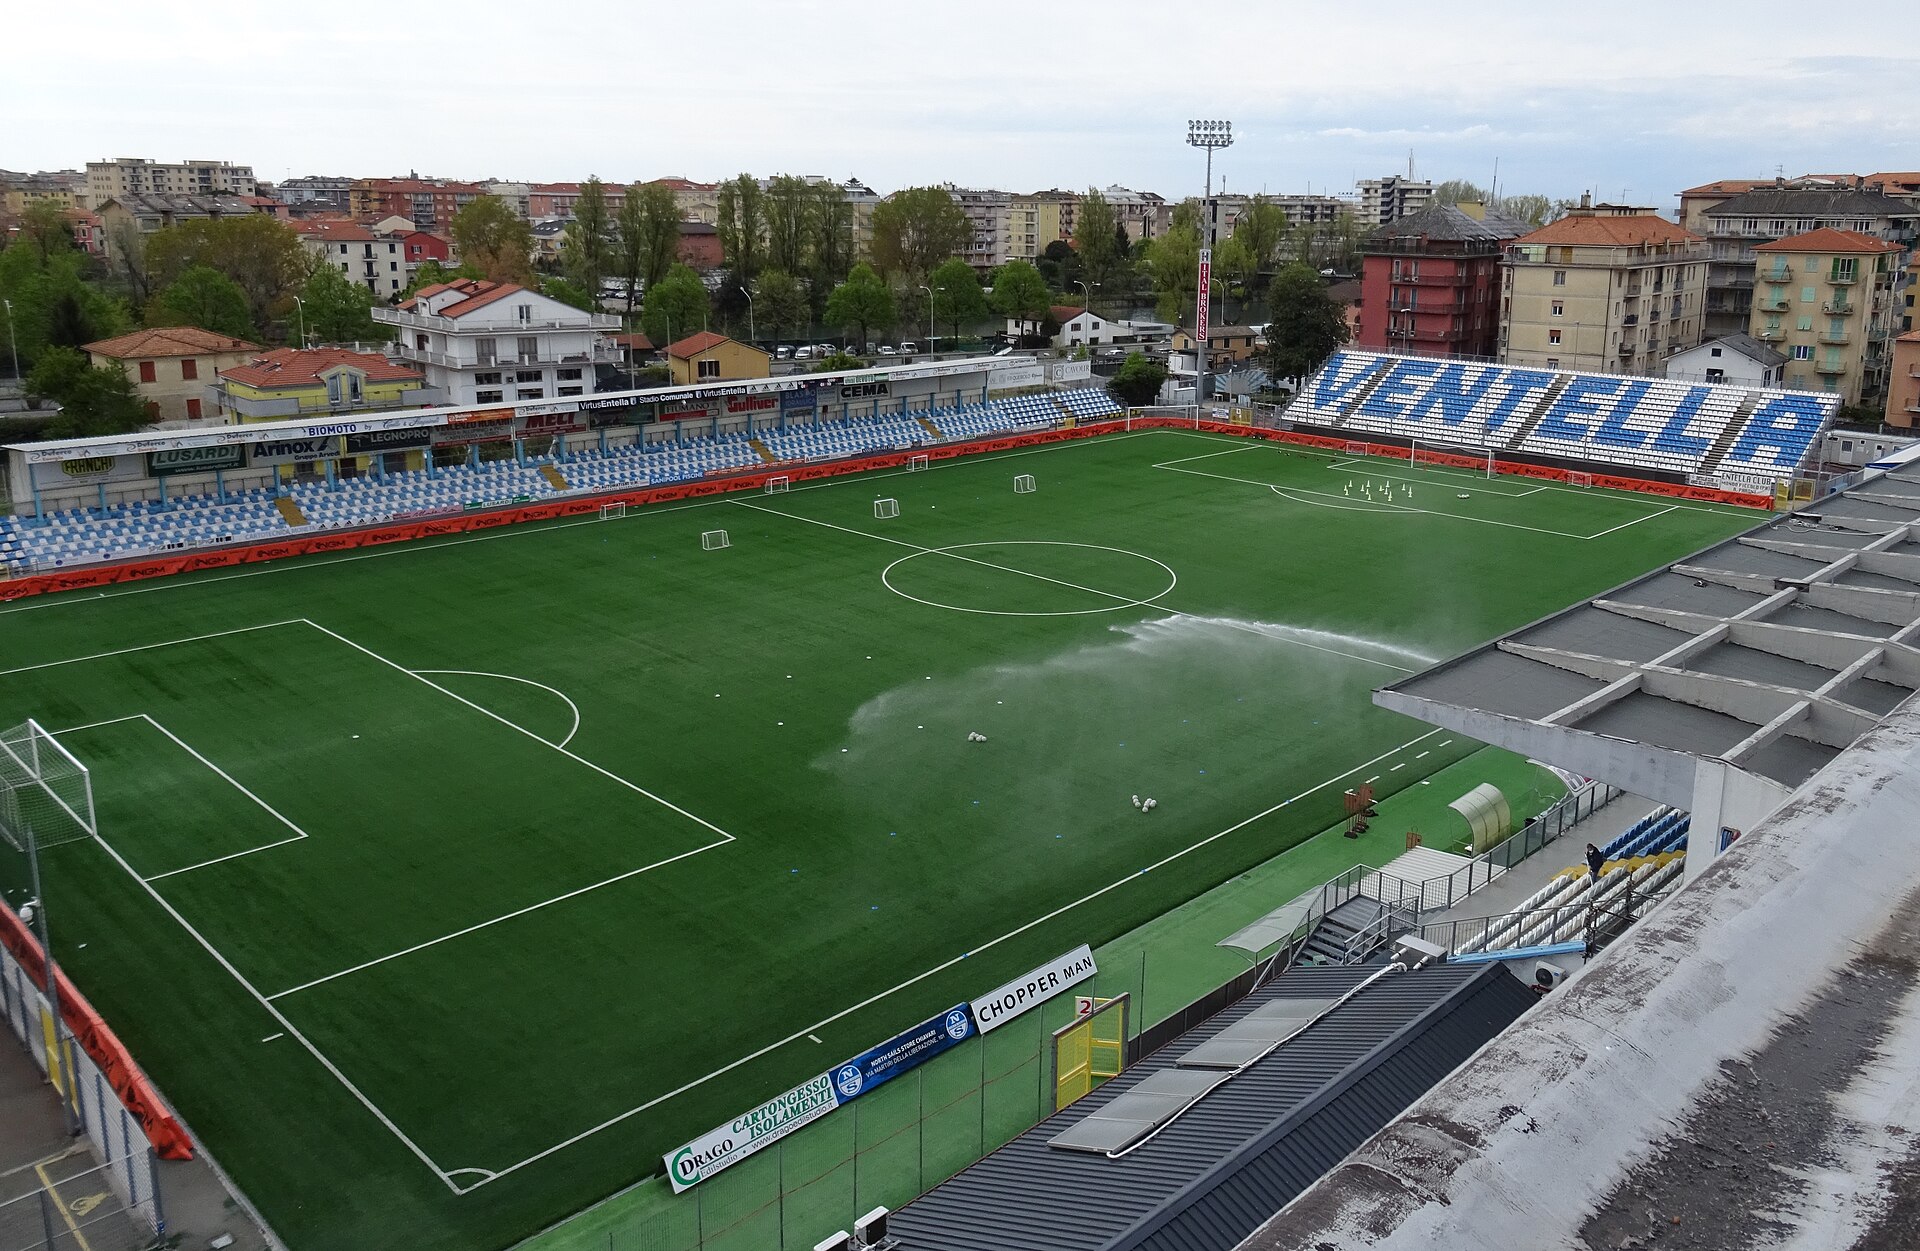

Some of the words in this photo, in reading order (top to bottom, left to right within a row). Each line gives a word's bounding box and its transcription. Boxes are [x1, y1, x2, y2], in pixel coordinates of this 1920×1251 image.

[1199, 294, 1207, 340] BROKERS
[660, 392, 694, 402] Comunale
[702, 388, 746, 398] VirtusEntella
[841, 384, 888, 398] CEMA
[580, 399, 629, 410] VirtusEntella
[308, 424, 356, 436] BIOMOTO
[370, 429, 428, 442] LEGNOPRO
[156, 446, 235, 464] LUSARDI
[1722, 473, 1750, 482] ENTELLA
[1753, 476, 1771, 486] CLUB
[980, 972, 1060, 1022] CHOPPER
[1063, 956, 1092, 980] MAN
[1080, 1000, 1091, 1014] 2
[870, 1054, 888, 1067] NORTH
[887, 1048, 901, 1060] SAILS
[900, 1040, 916, 1052] STORE
[915, 1030, 936, 1044] CHIAVARI
[874, 1060, 894, 1074] MARTIRI
[894, 1053, 908, 1064] DELLA
[732, 1076, 829, 1134] CARTONGESSO
[750, 1087, 833, 1140] ISOLAMENTI
[752, 1102, 834, 1150] www.dragoedilstudio.it
[680, 1139, 733, 1176] DRAGO
[700, 1154, 738, 1178] Edilstudio
